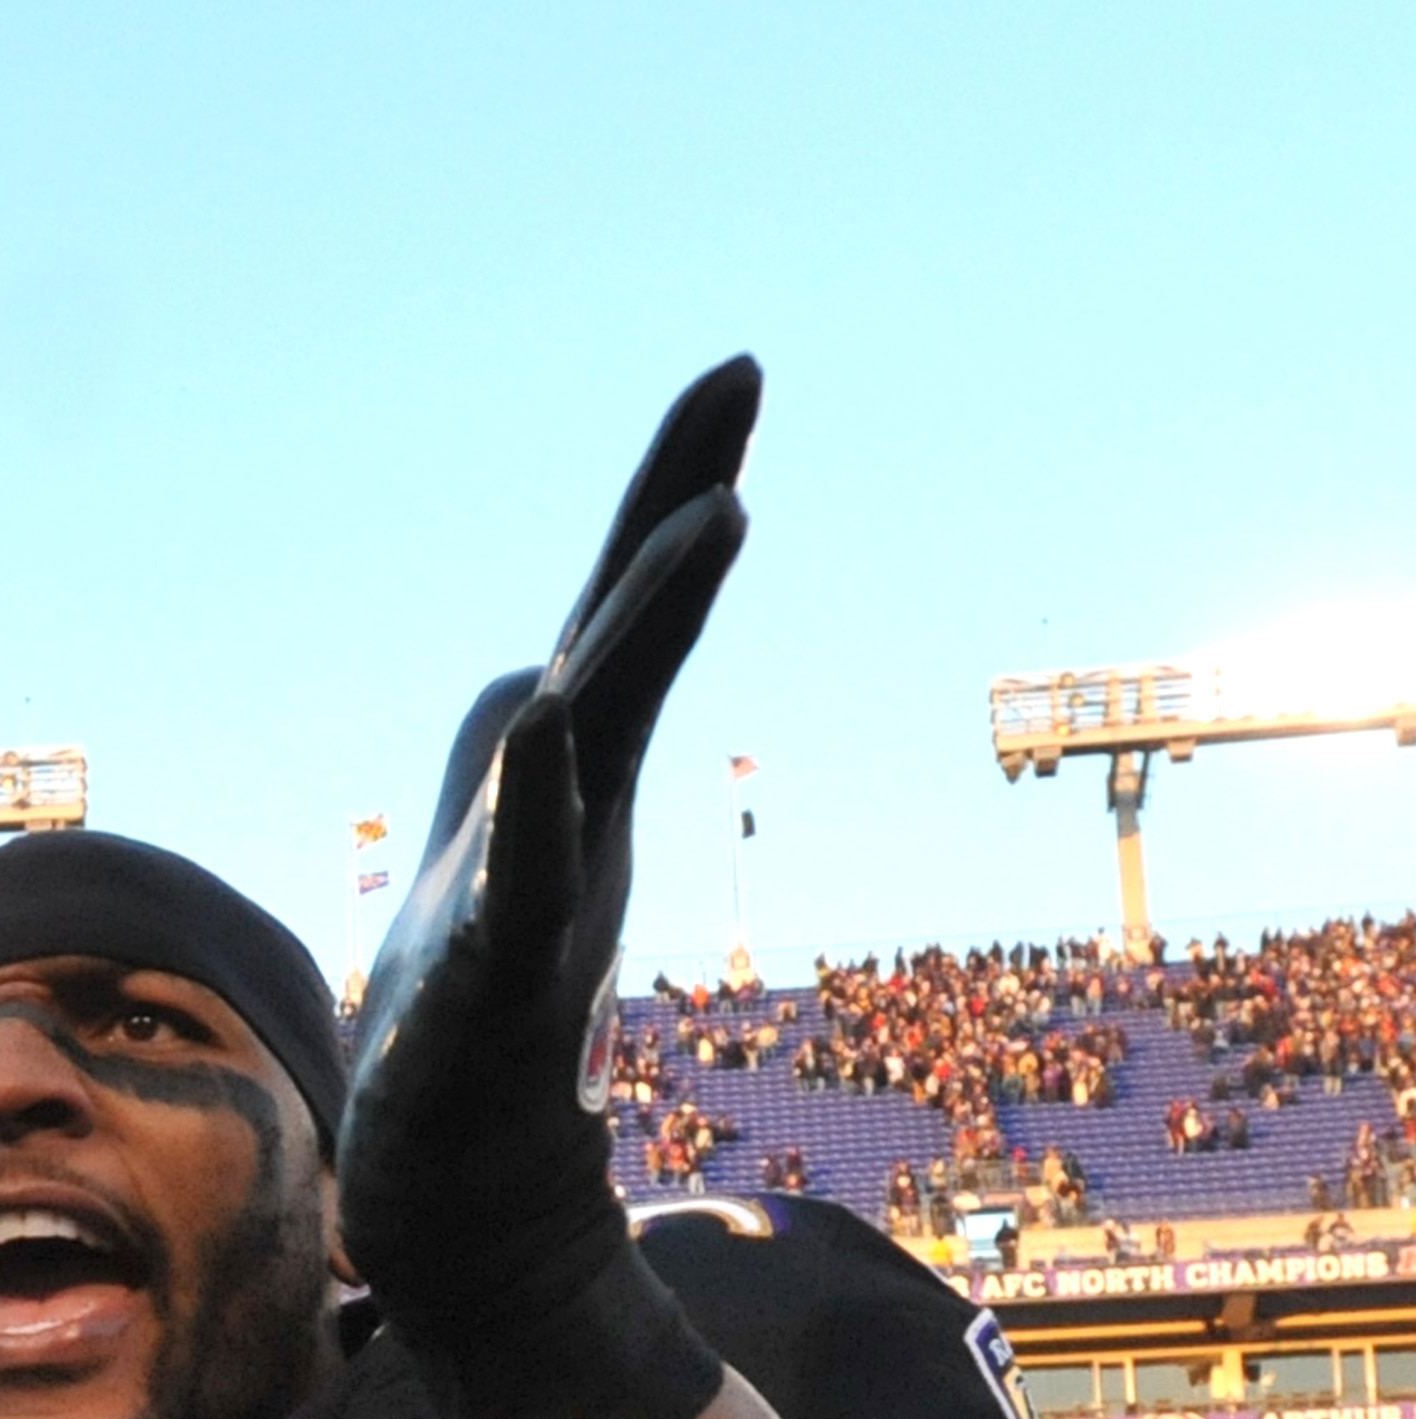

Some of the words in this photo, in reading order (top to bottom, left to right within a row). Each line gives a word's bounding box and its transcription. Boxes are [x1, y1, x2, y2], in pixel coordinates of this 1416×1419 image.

[981, 1271, 1047, 1299] AFC
[1056, 1264, 1175, 1297] NORTH
[1185, 1250, 1389, 1287] CHAMPIONS
